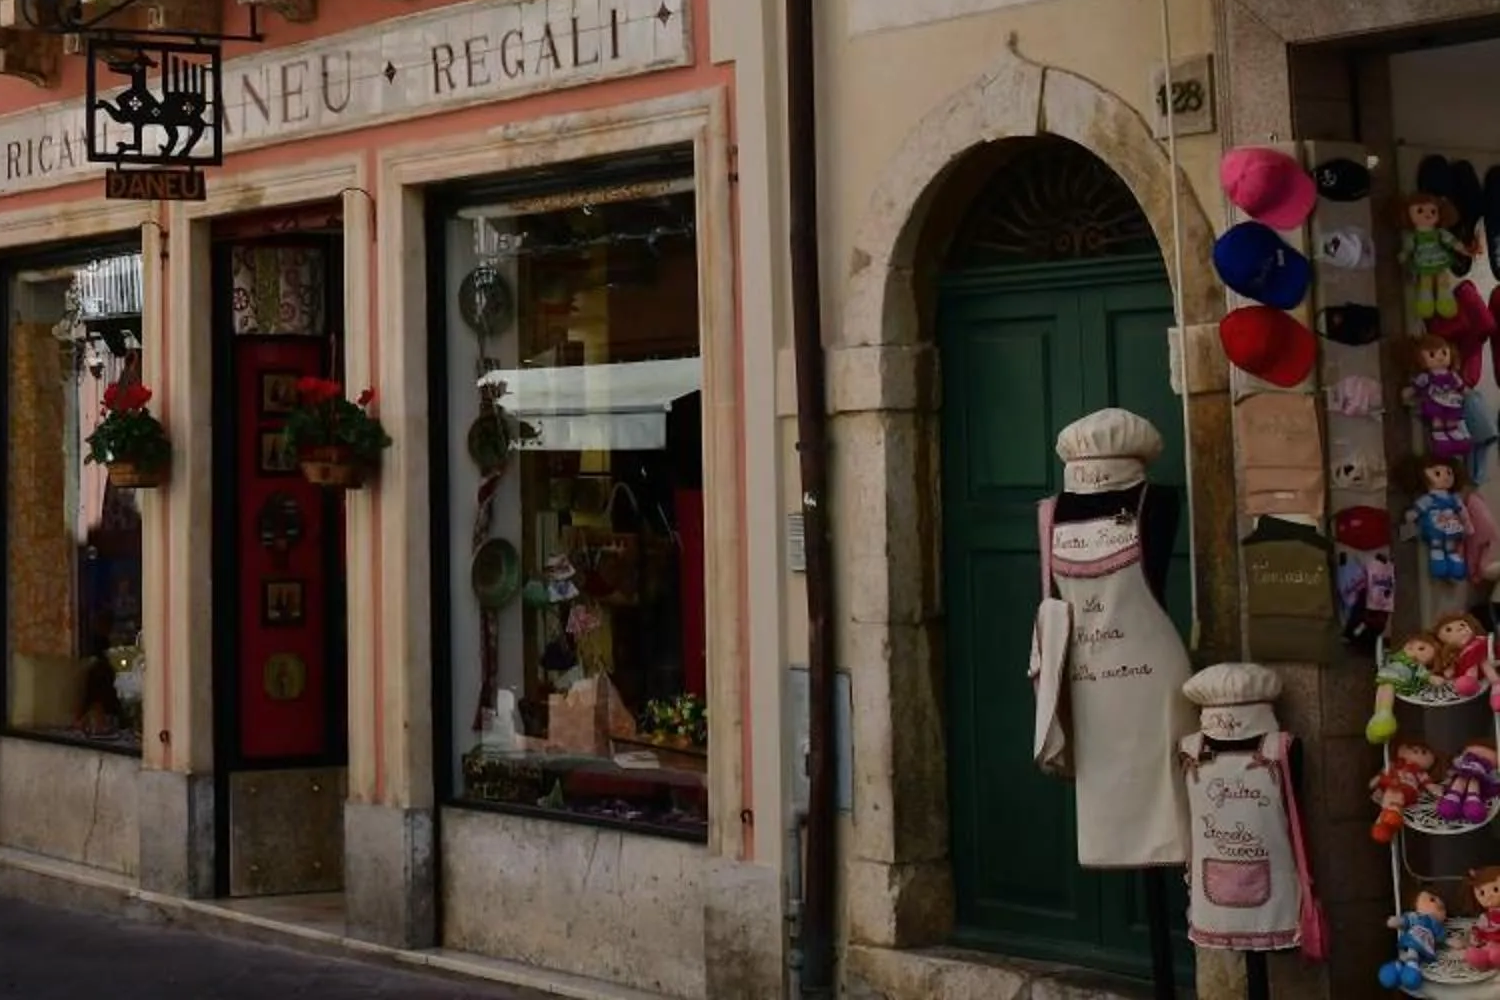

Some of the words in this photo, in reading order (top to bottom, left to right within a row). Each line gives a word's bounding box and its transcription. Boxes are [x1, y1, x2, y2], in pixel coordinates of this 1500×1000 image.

[431, 8, 619, 95] REGALI
[1155, 80, 1203, 117] 128
[109, 173, 199, 198] DANEU
